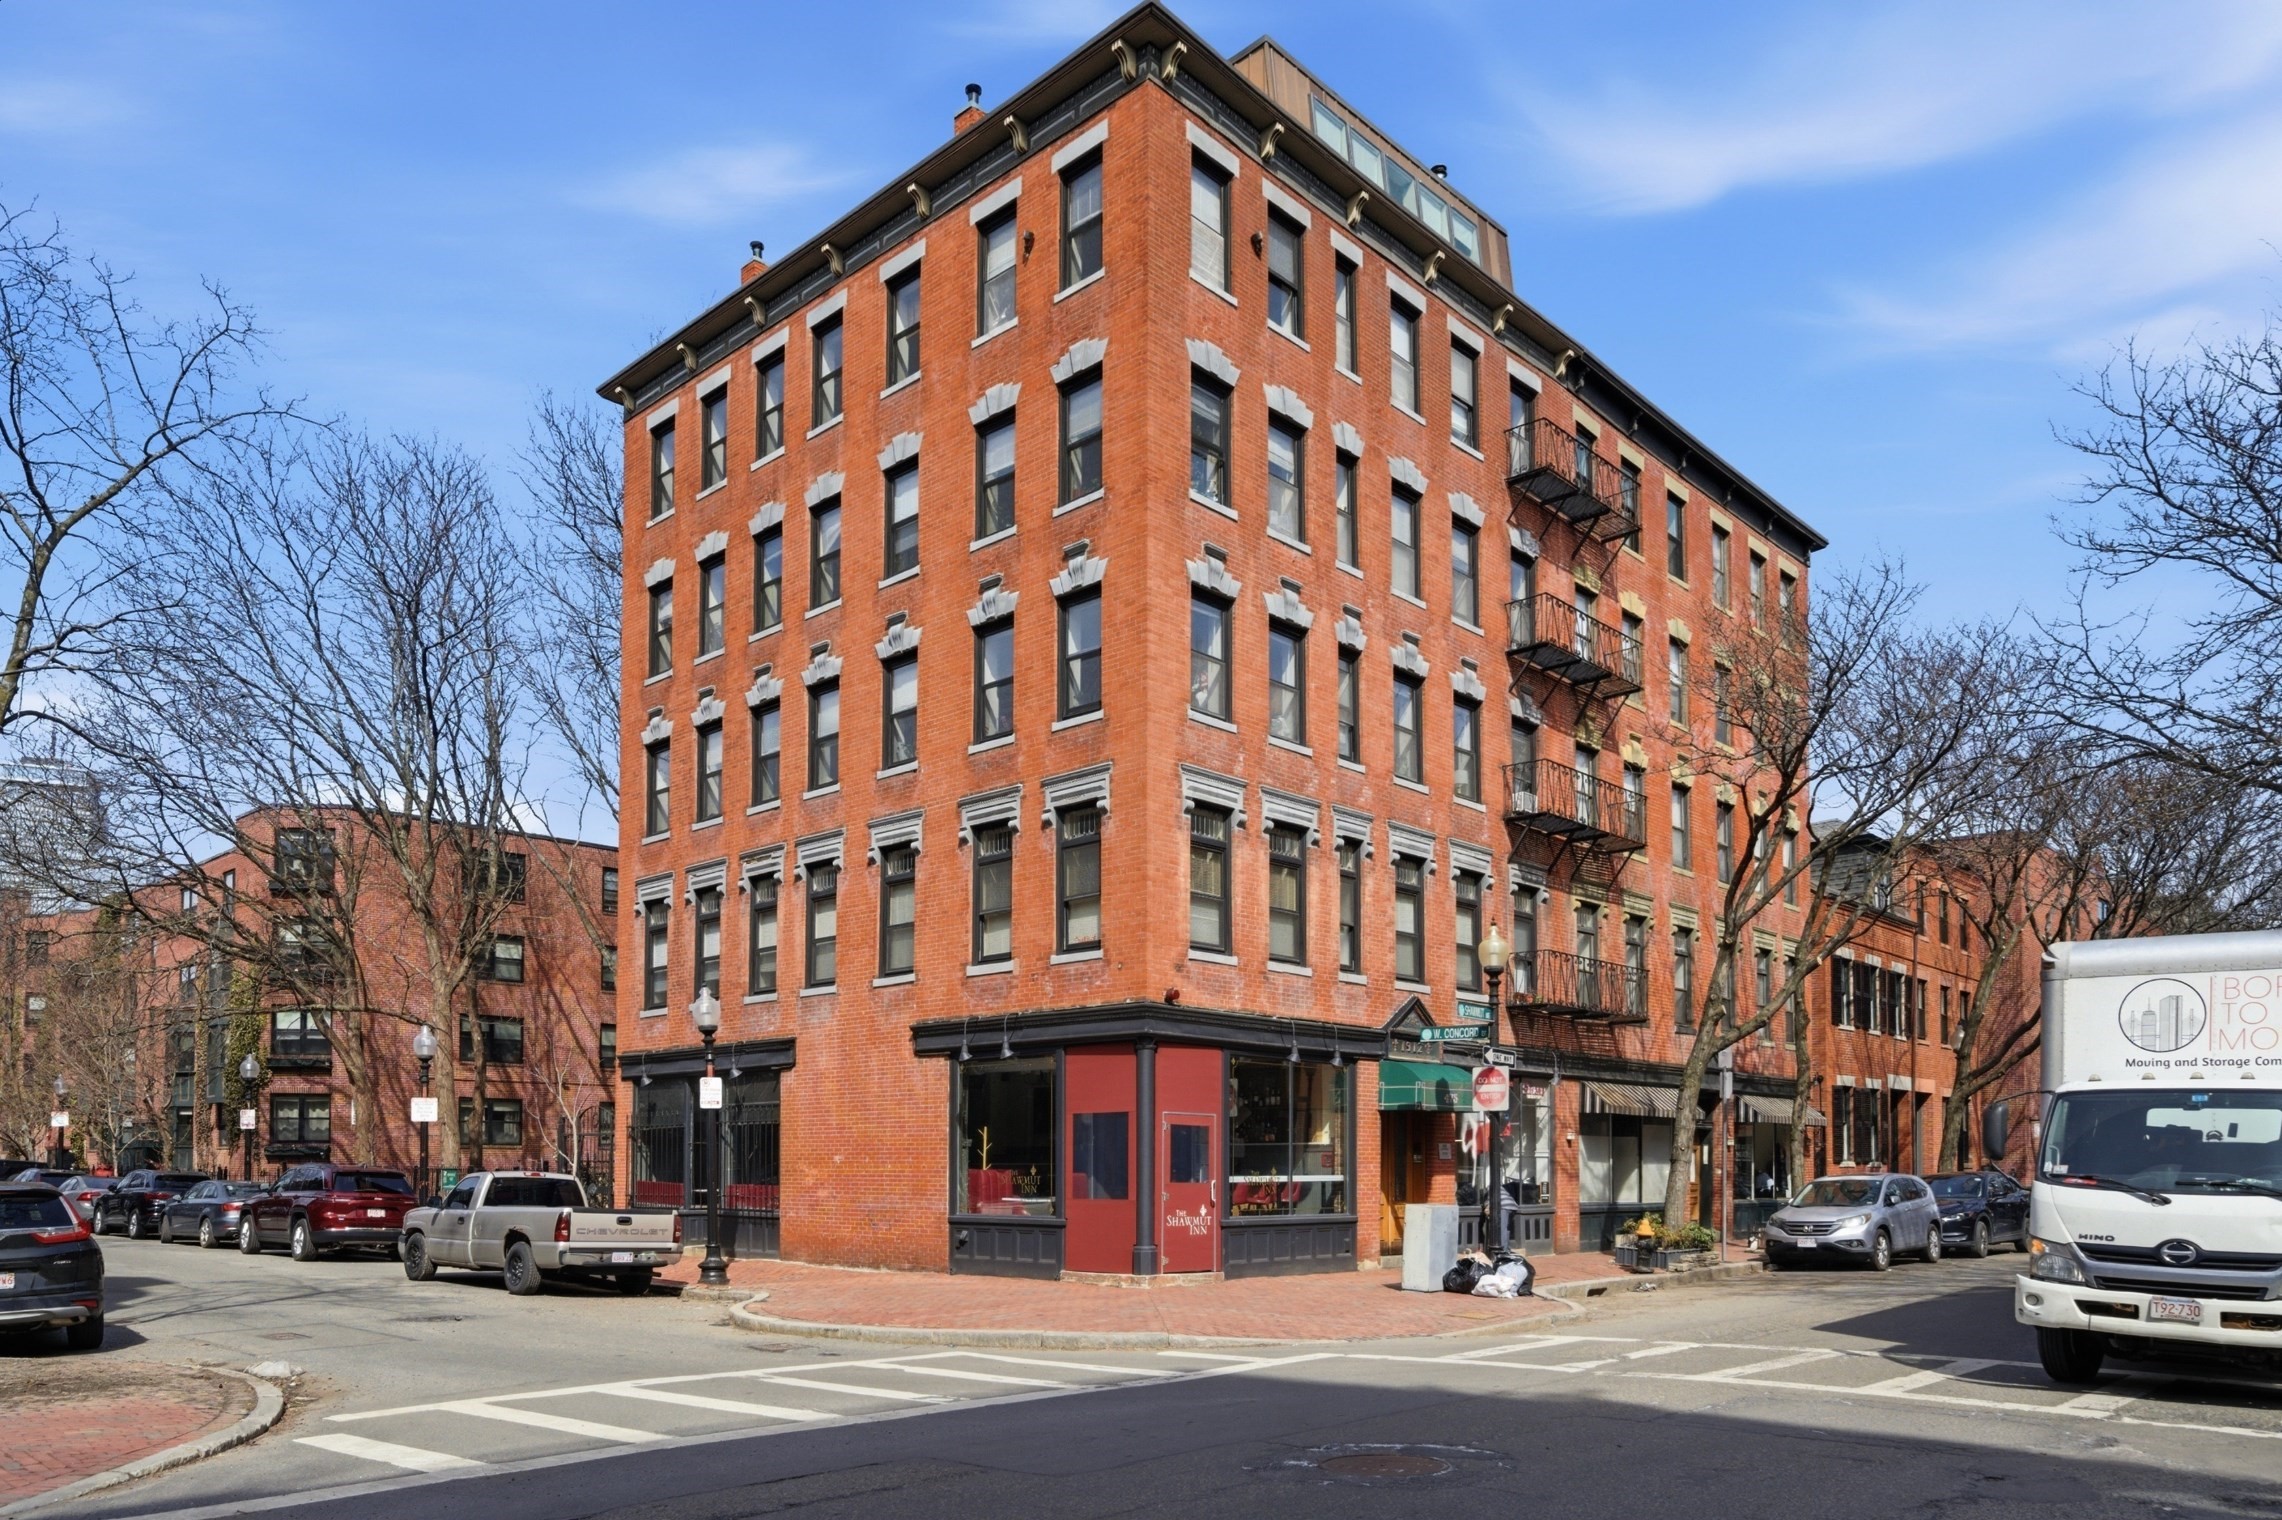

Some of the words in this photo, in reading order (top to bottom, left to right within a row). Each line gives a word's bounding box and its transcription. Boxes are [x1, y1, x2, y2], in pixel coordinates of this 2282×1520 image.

[2221, 1001, 2268, 1025] TO
[1433, 1029, 1443, 1039] W.
[1444, 1027, 1479, 1039] CONCORD
[1401, 1041, 1423, 1053] 1912
[1492, 1053, 1502, 1062] ONE
[2125, 1057, 2171, 1069] Moving
[2174, 1057, 2199, 1067] and
[2202, 1057, 2251, 1069] Storage
[1176, 1209, 1187, 1217] THE
[1166, 1214, 1212, 1227] SHAWMUT
[576, 1227, 668, 1236] CHEVROLET
[1189, 1225, 1208, 1235] INN
[2078, 1233, 2115, 1242] HINO
